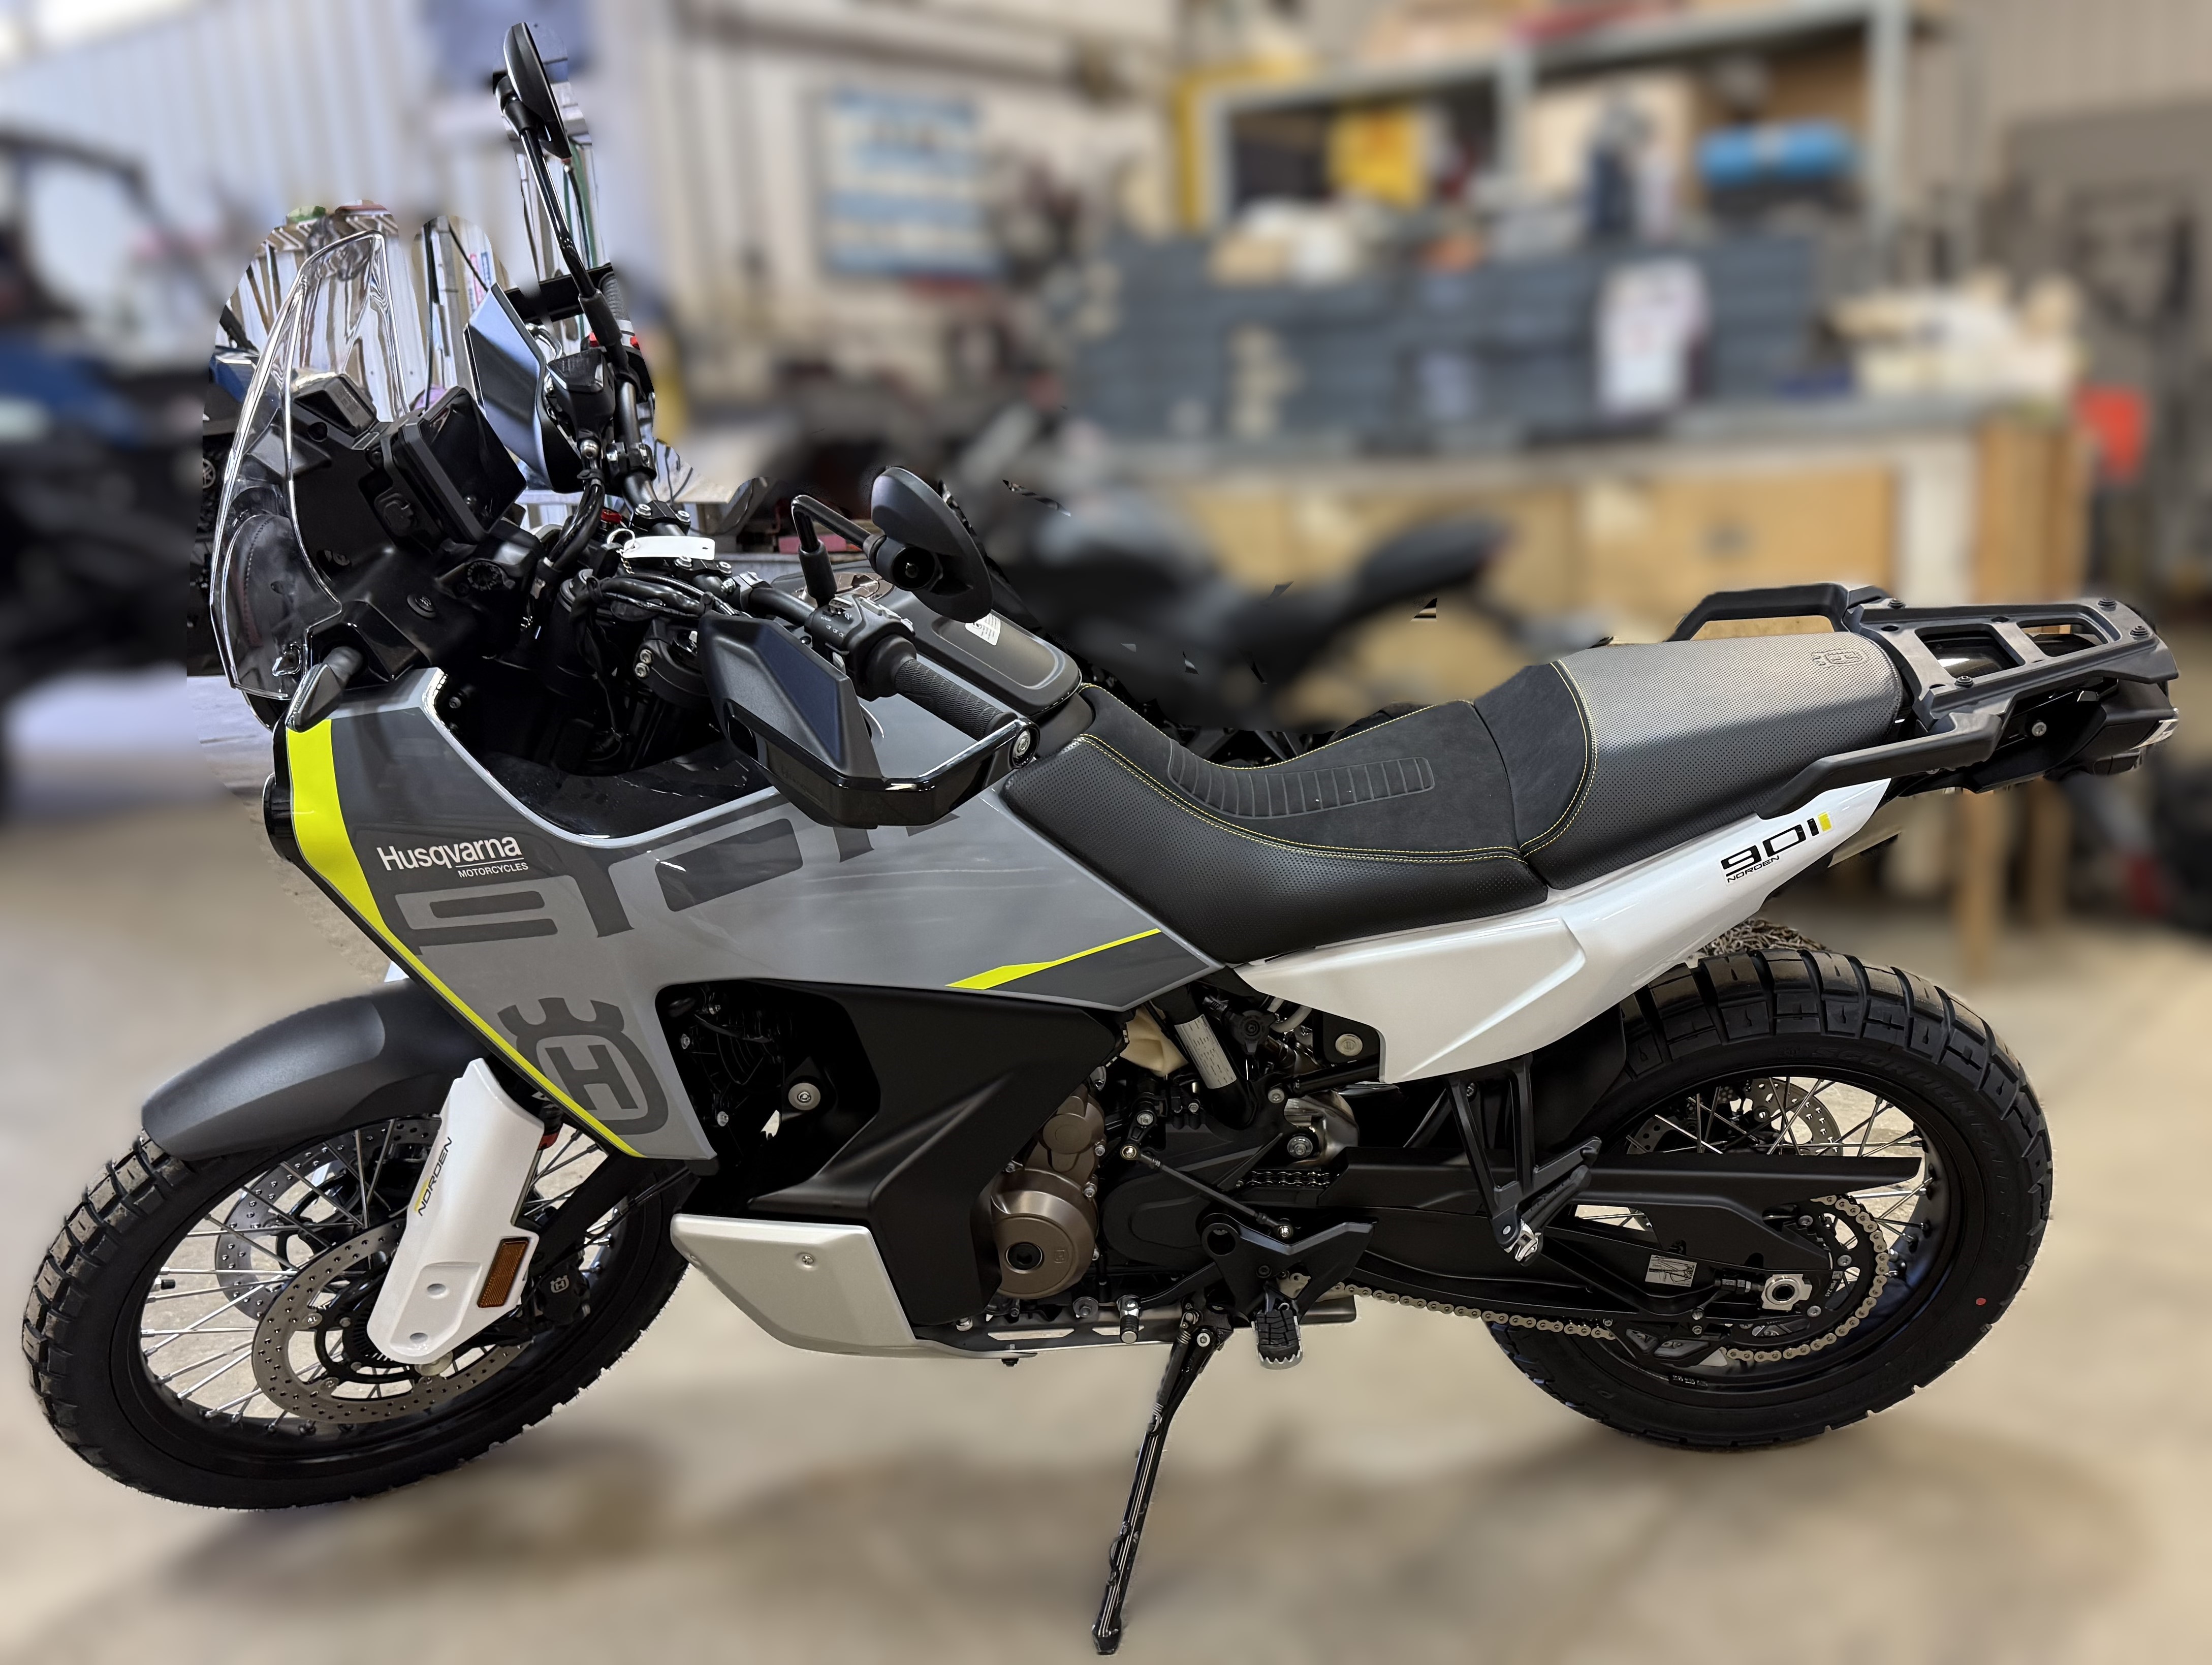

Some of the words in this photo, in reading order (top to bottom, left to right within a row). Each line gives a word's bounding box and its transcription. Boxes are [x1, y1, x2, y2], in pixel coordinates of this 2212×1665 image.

[376, 836, 522, 871] Husqvarna
[1721, 818, 1819, 877] 901
[457, 862, 529, 878] MOTORCYCLES
[1727, 855, 1780, 883] NORDEN
[418, 1137, 452, 1216] NORDEN
